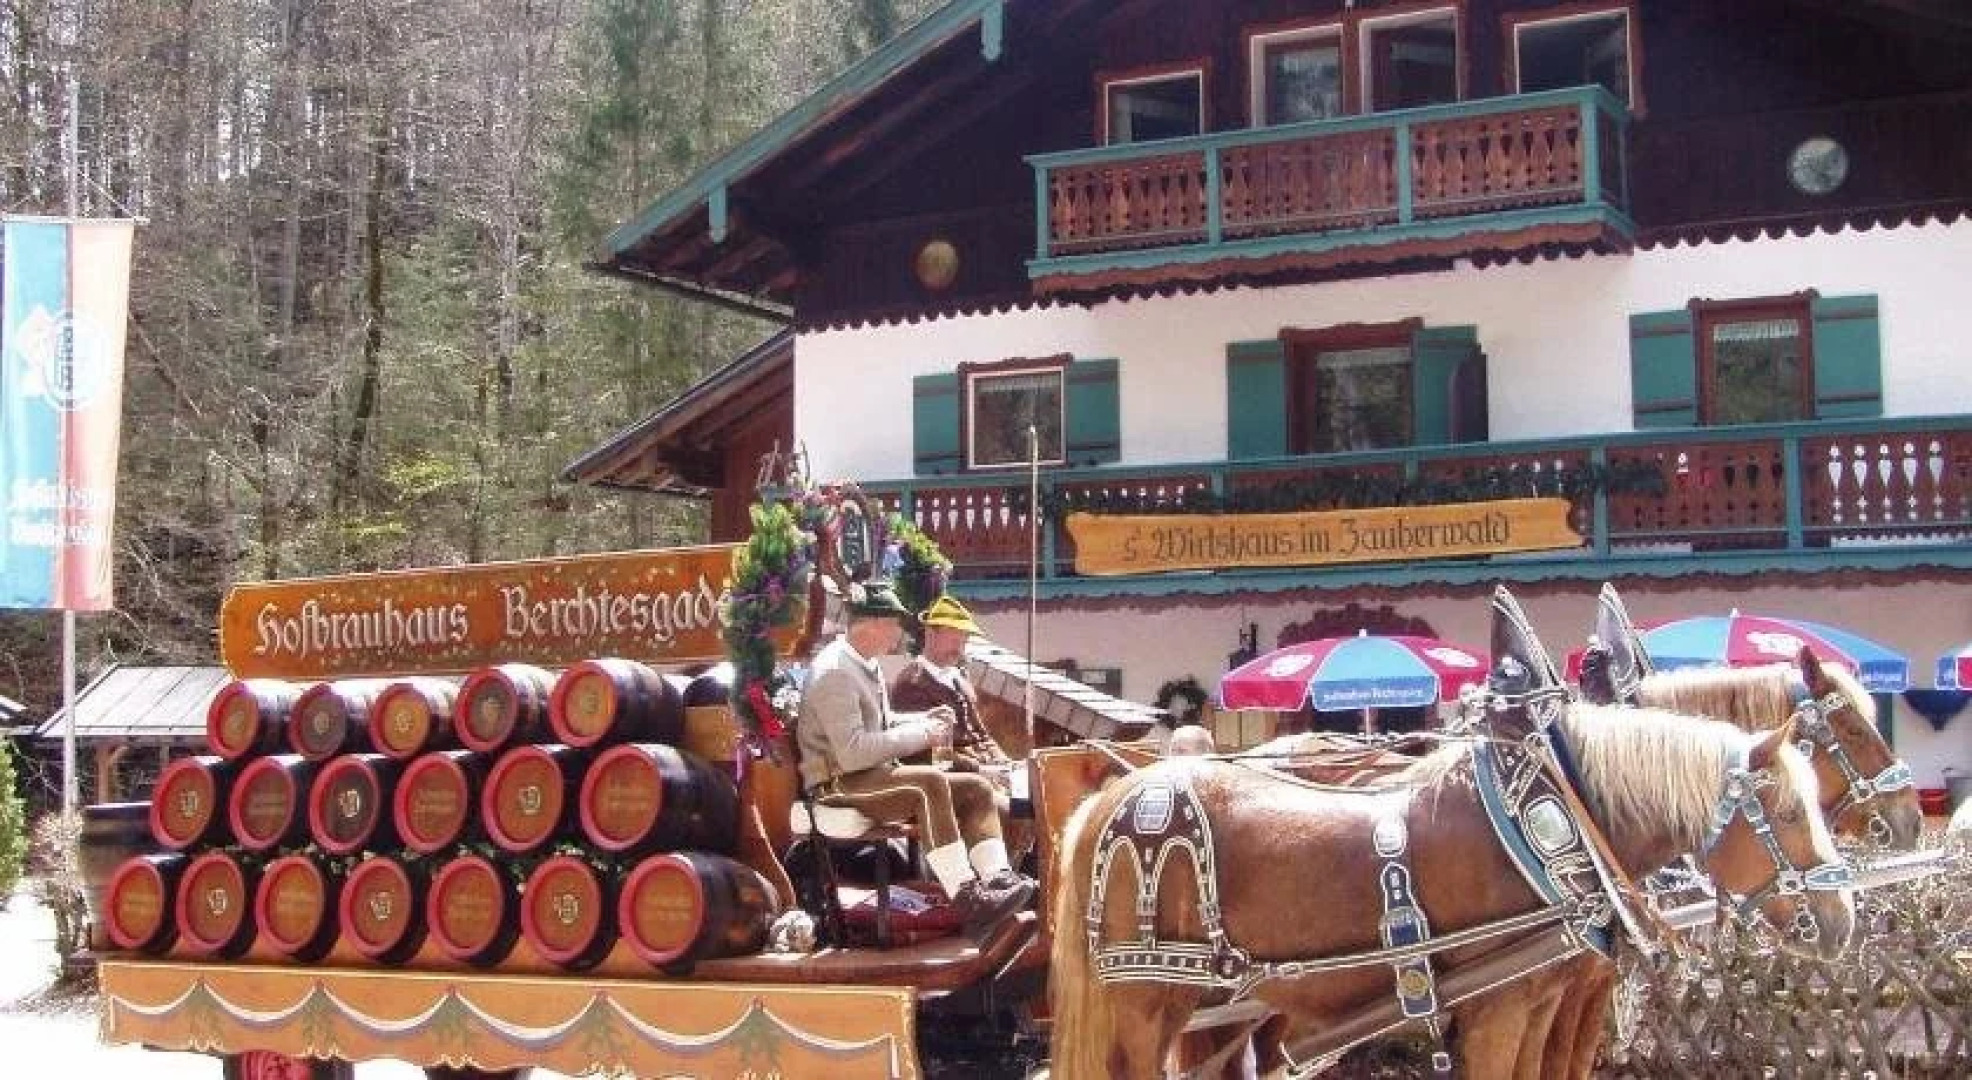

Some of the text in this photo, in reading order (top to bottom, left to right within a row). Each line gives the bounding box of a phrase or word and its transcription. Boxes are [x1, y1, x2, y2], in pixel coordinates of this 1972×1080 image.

[1151, 525, 1294, 561] Wirtshaus
[1299, 521, 1330, 554] im
[1338, 511, 1511, 555] Zauberwald
[499, 573, 732, 643] Berchtesgade
